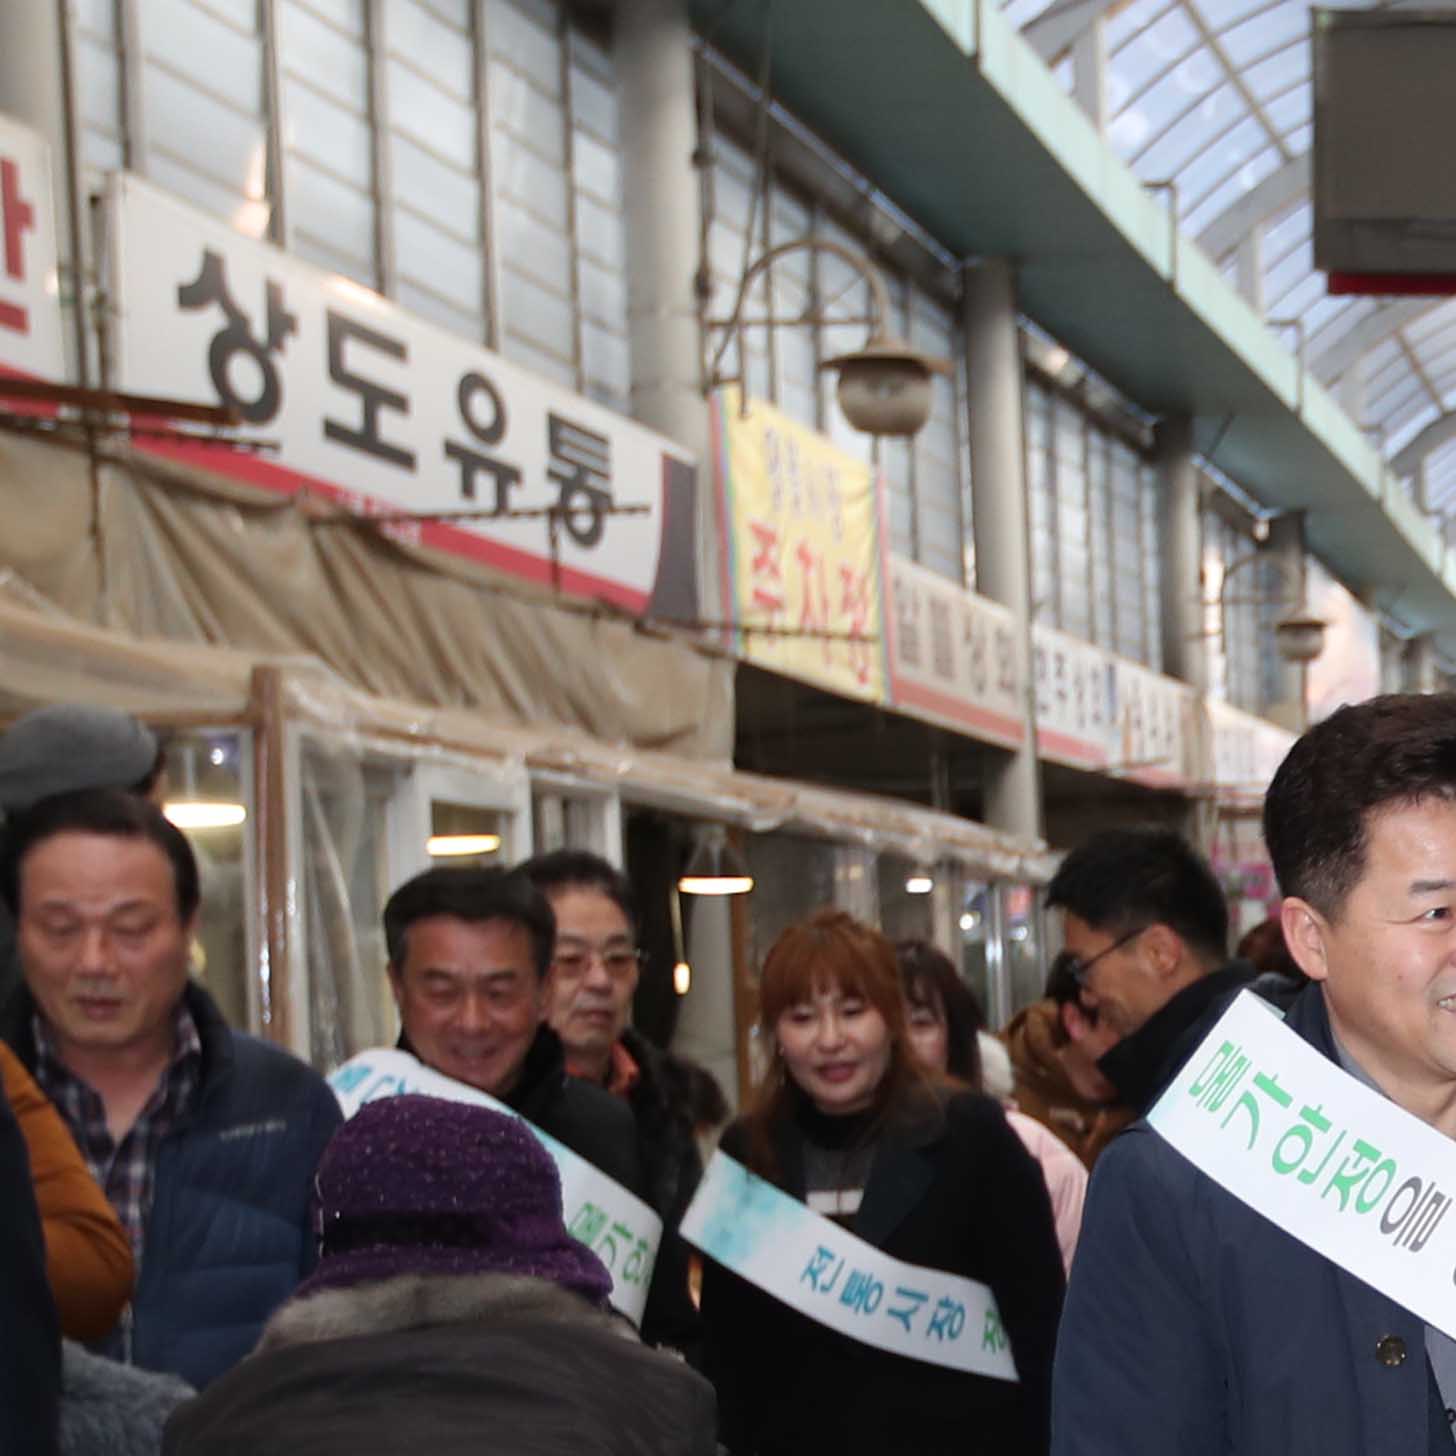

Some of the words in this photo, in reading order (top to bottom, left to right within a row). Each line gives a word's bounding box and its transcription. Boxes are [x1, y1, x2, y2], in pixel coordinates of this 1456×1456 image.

[177, 248, 616, 550] 상도유통
[1188, 1039, 1453, 1254] 물가안정을
[799, 1244, 965, 1342] 전통시장
